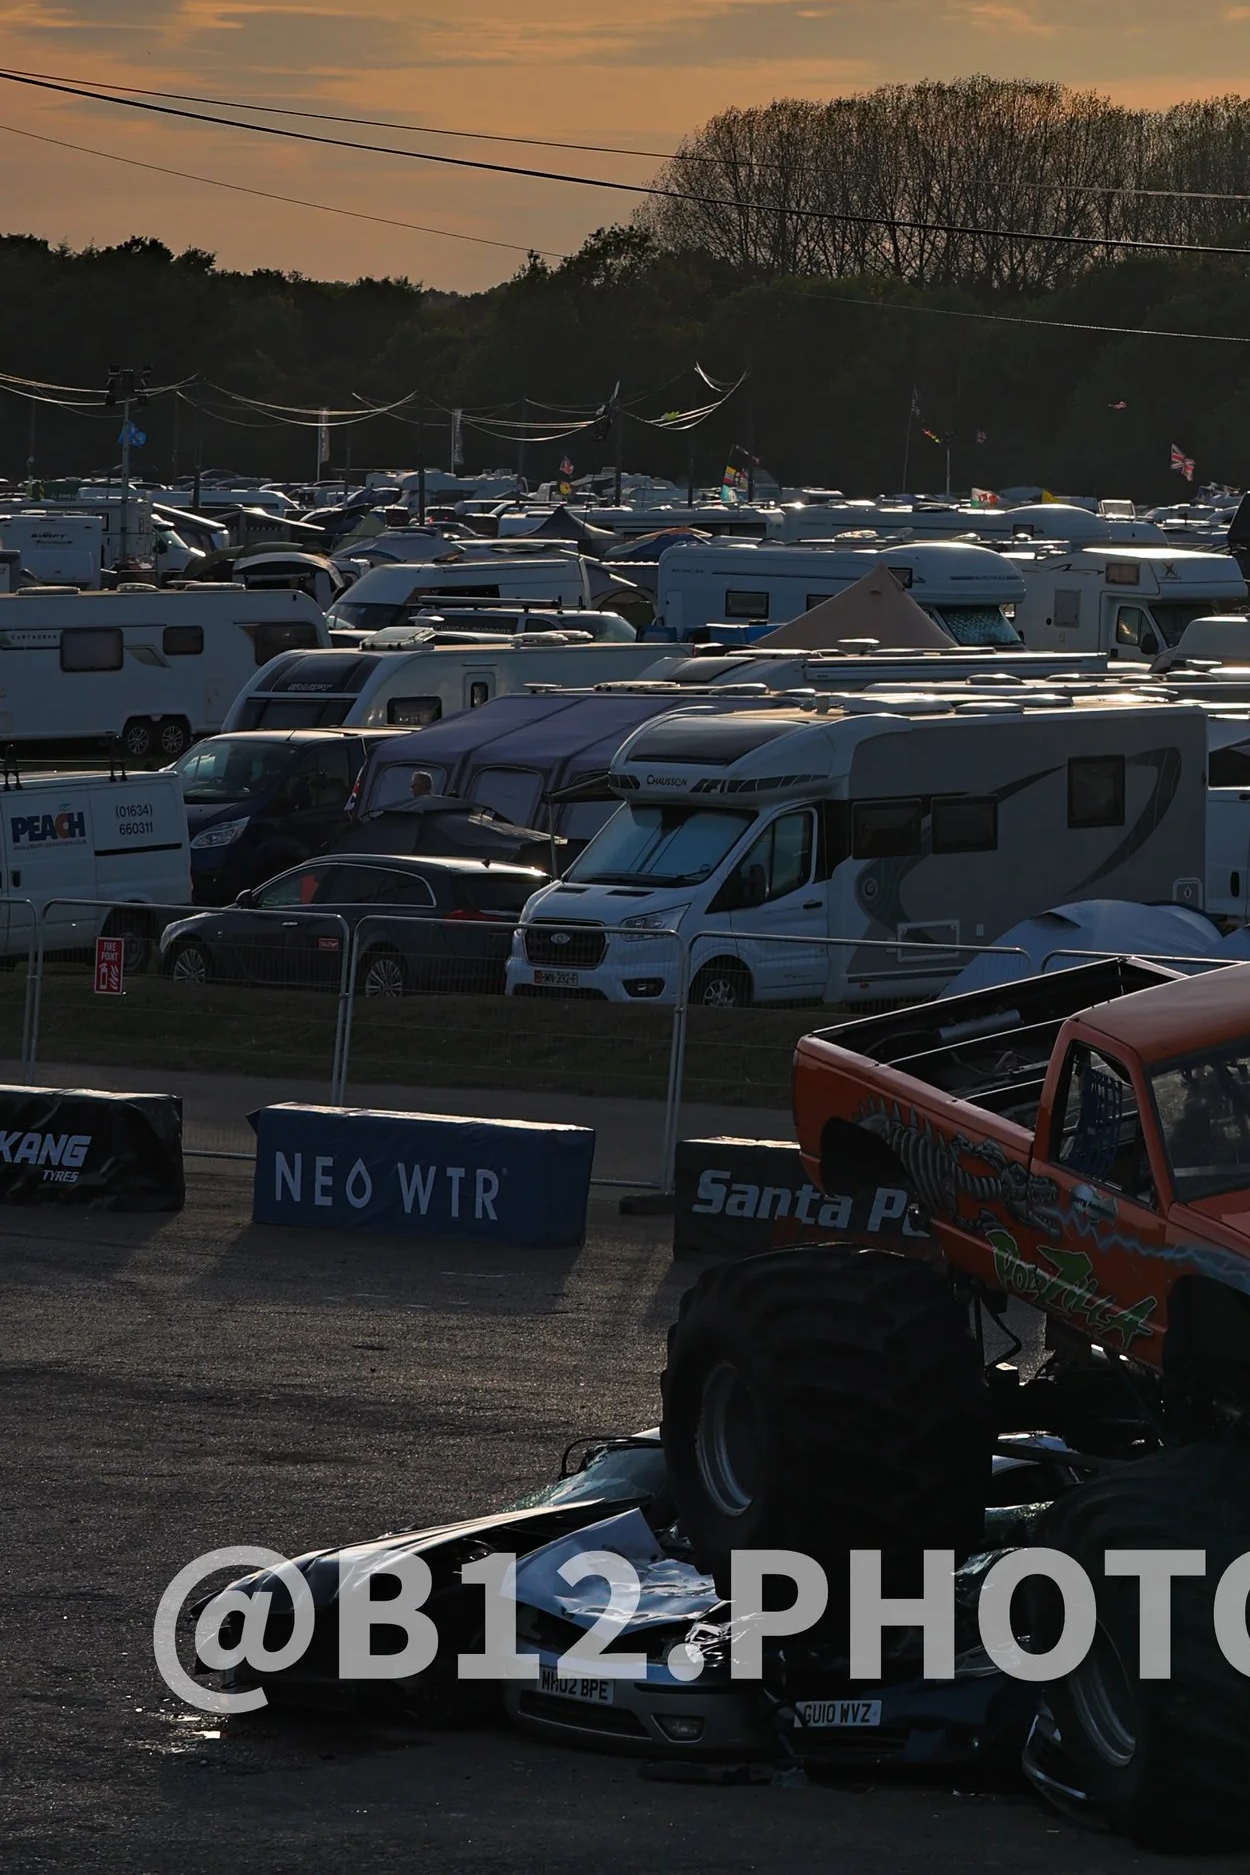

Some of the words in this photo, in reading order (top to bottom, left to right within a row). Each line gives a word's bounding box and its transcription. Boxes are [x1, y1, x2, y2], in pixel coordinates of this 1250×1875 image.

[115, 804, 153, 819] (01634)
[11, 811, 86, 843] PEACH
[119, 821, 153, 836] 660311
[103, 941, 117, 952] FIRE
[101, 951, 118, 963] POINT
[42, 1169, 80, 1183] TYRES
[397, 1161, 500, 1221] WTR
[692, 1169, 854, 1230] Santa
[579, 1678, 609, 1701] BPE
[840, 1702, 873, 1723] WVZ
